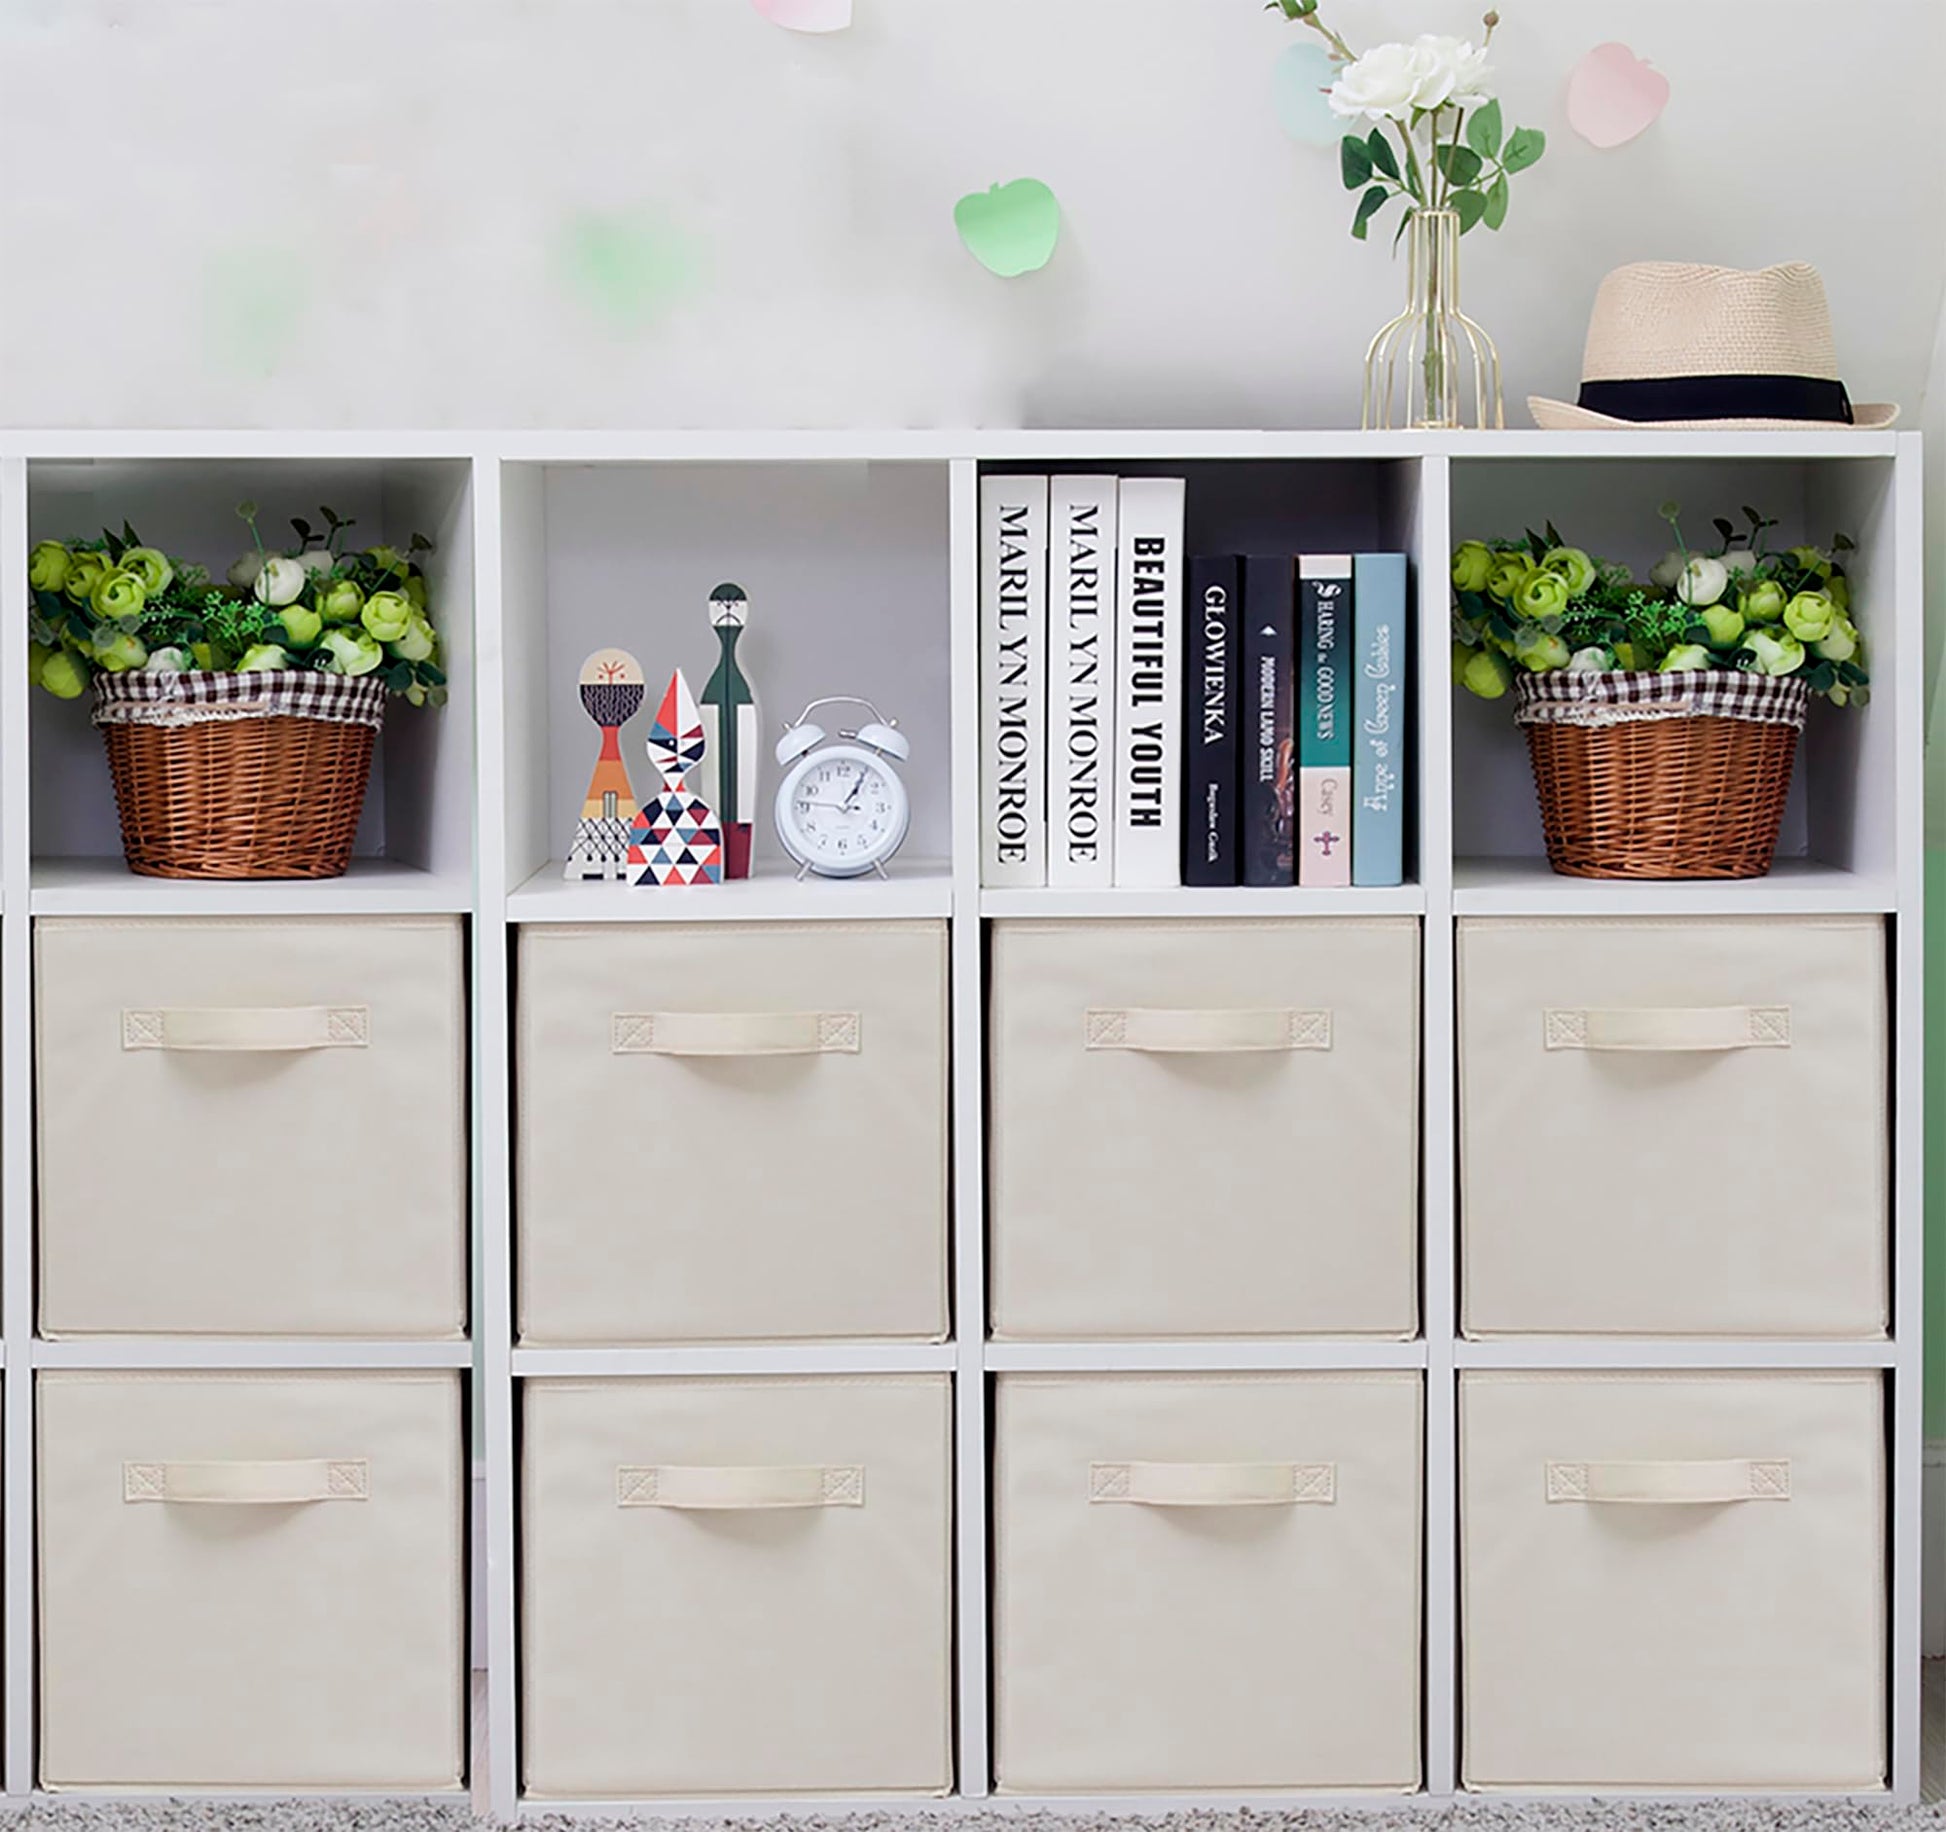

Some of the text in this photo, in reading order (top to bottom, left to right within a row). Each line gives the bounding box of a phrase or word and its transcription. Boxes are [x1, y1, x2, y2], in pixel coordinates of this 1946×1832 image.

[1364, 623, 1390, 678] Gables
[1130, 537, 1165, 827] BEAUTIFUL YOUTH
[1261, 656, 1275, 709] MODERN
[1317, 666, 1335, 703] GOOD
[1317, 704, 1334, 740] NEWS
[997, 696, 1028, 863] MONROE
[1068, 696, 1098, 863] MONROE
[1260, 747, 1274, 782] SKILL
[1317, 779, 1338, 816] Casey
